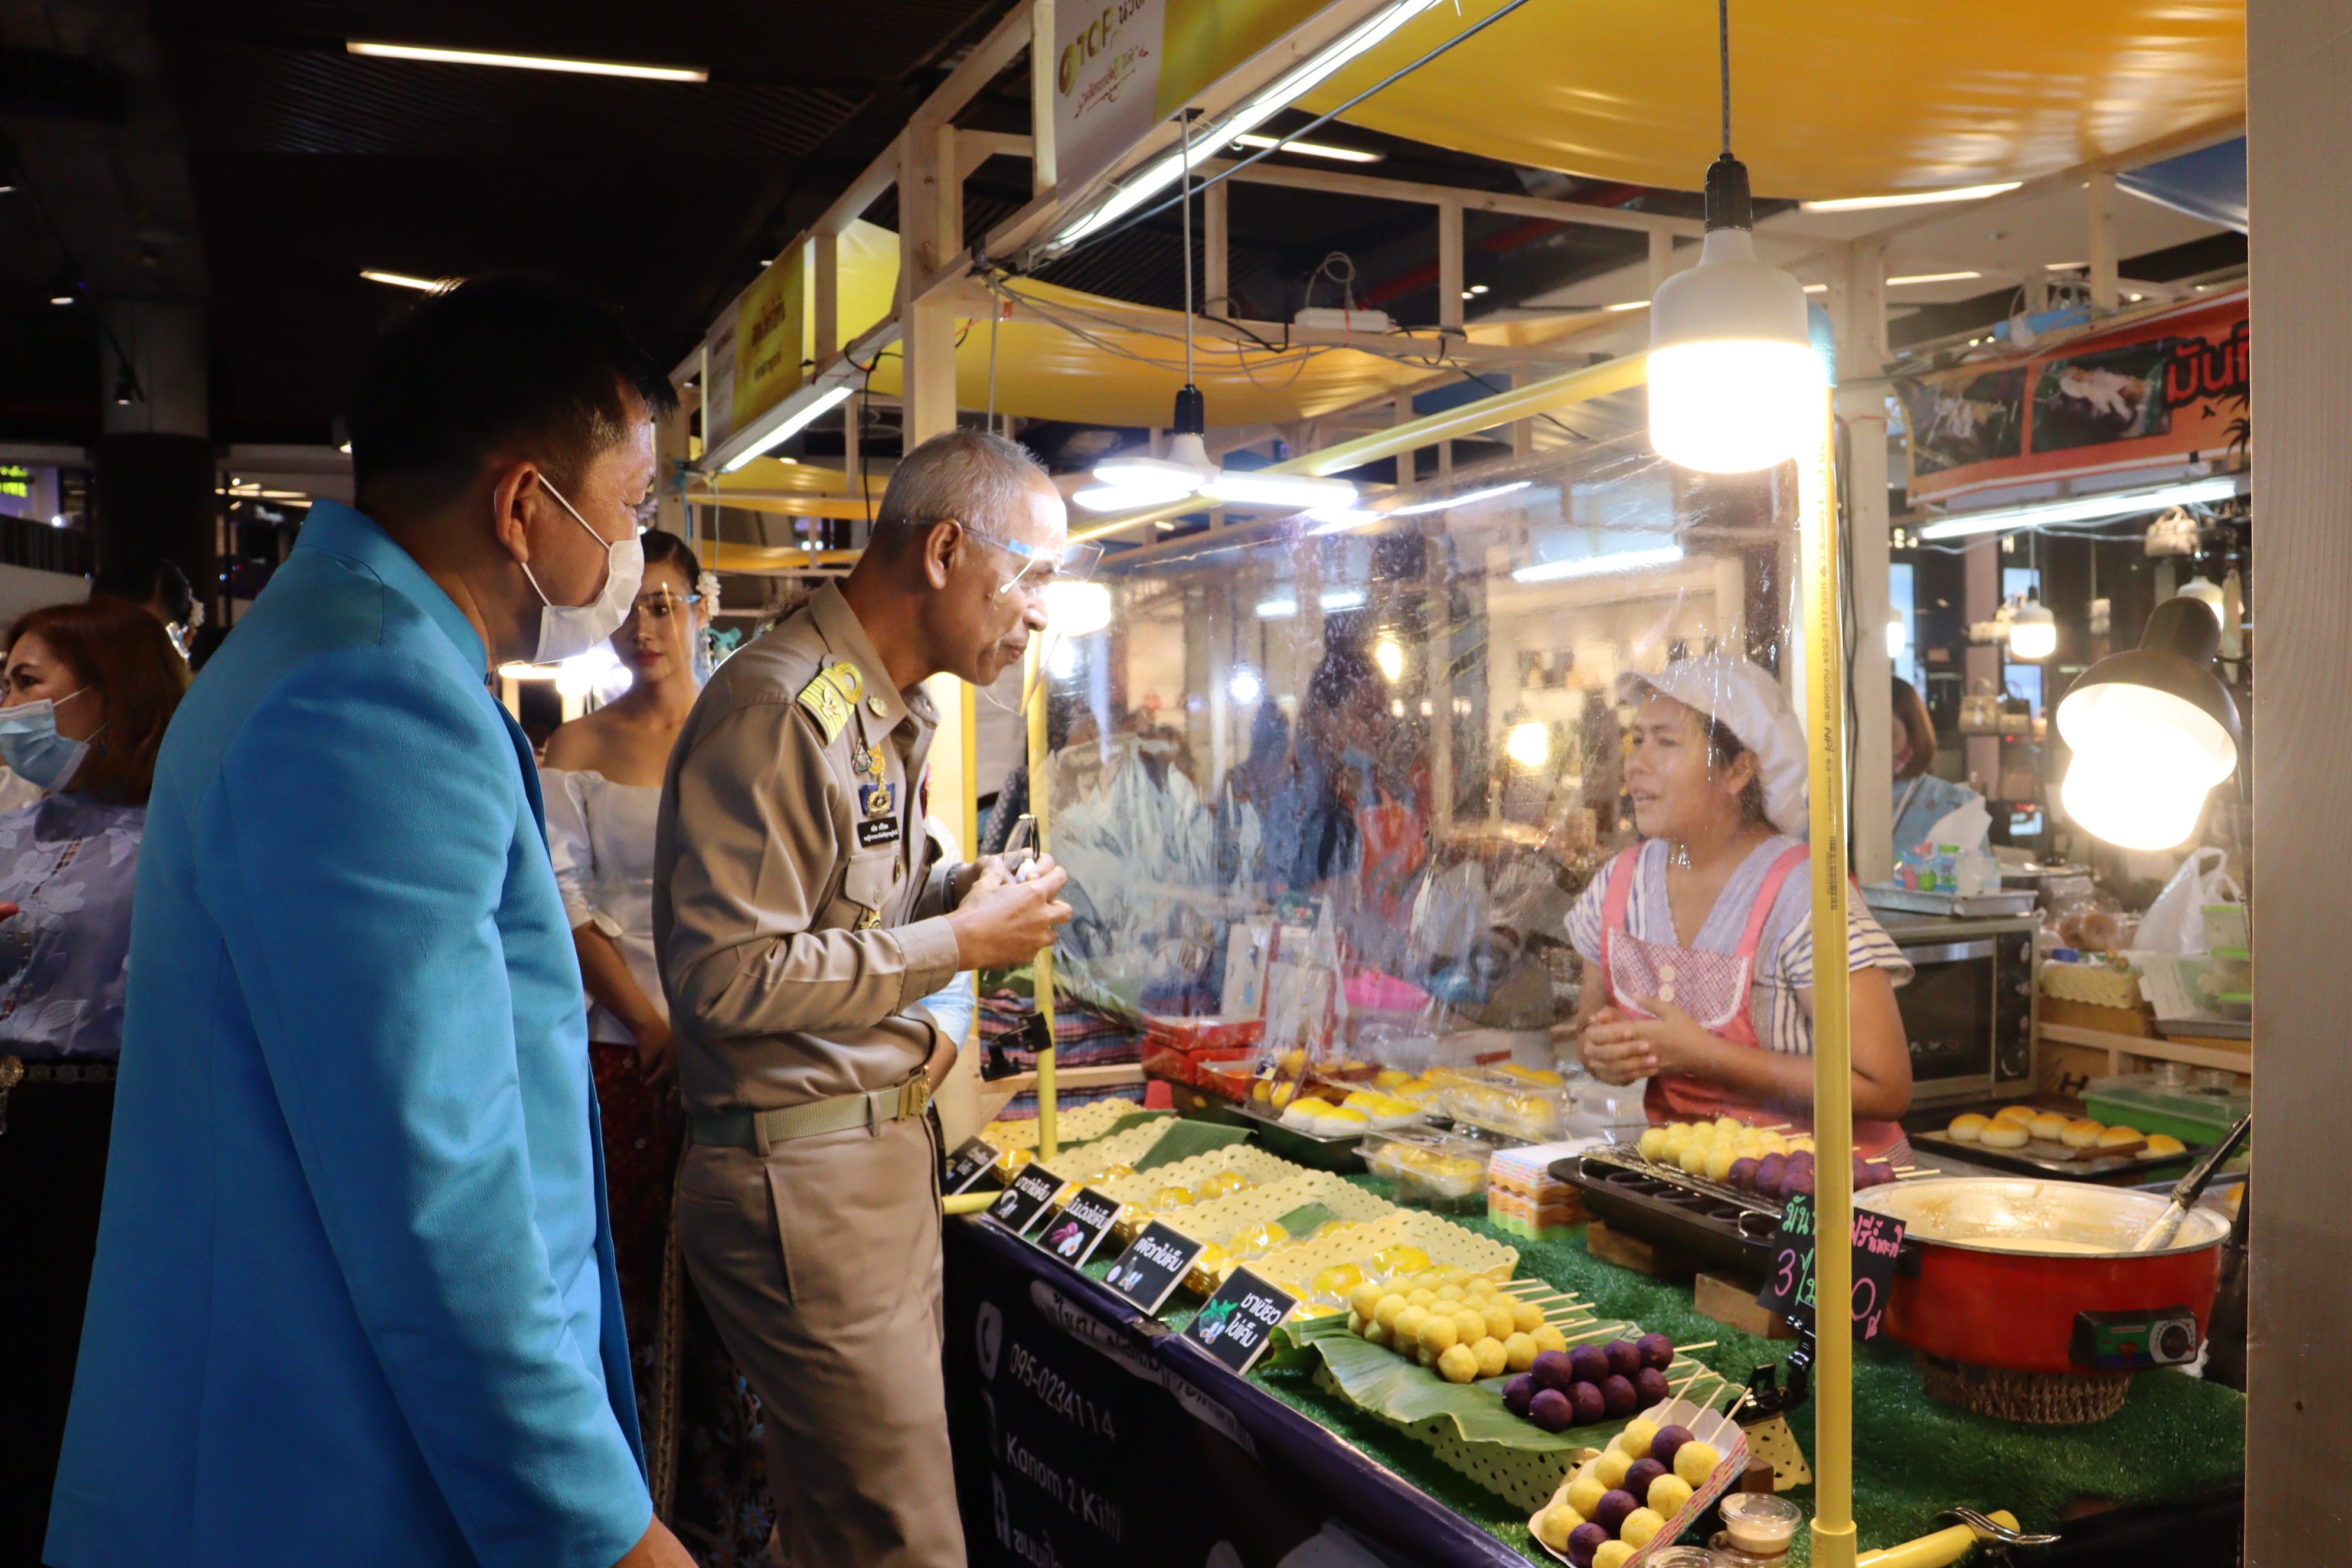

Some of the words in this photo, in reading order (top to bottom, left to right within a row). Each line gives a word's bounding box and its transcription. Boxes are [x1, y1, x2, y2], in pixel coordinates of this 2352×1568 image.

[1824, 727, 1835, 753] NPI
[1782, 1195, 1815, 1236] มัน
[1133, 1237, 1184, 1272] เผือกไข่เค็ม
[1774, 1249, 1796, 1297] 3
[1240, 1292, 1282, 1325] ชาเขียว
[1225, 1312, 1259, 1348] ไข่เค็ม
[1010, 1343, 1116, 1443] 095-0234114
[1007, 1431, 1062, 1501] Kanom
[1067, 1478, 1076, 1514] 2
